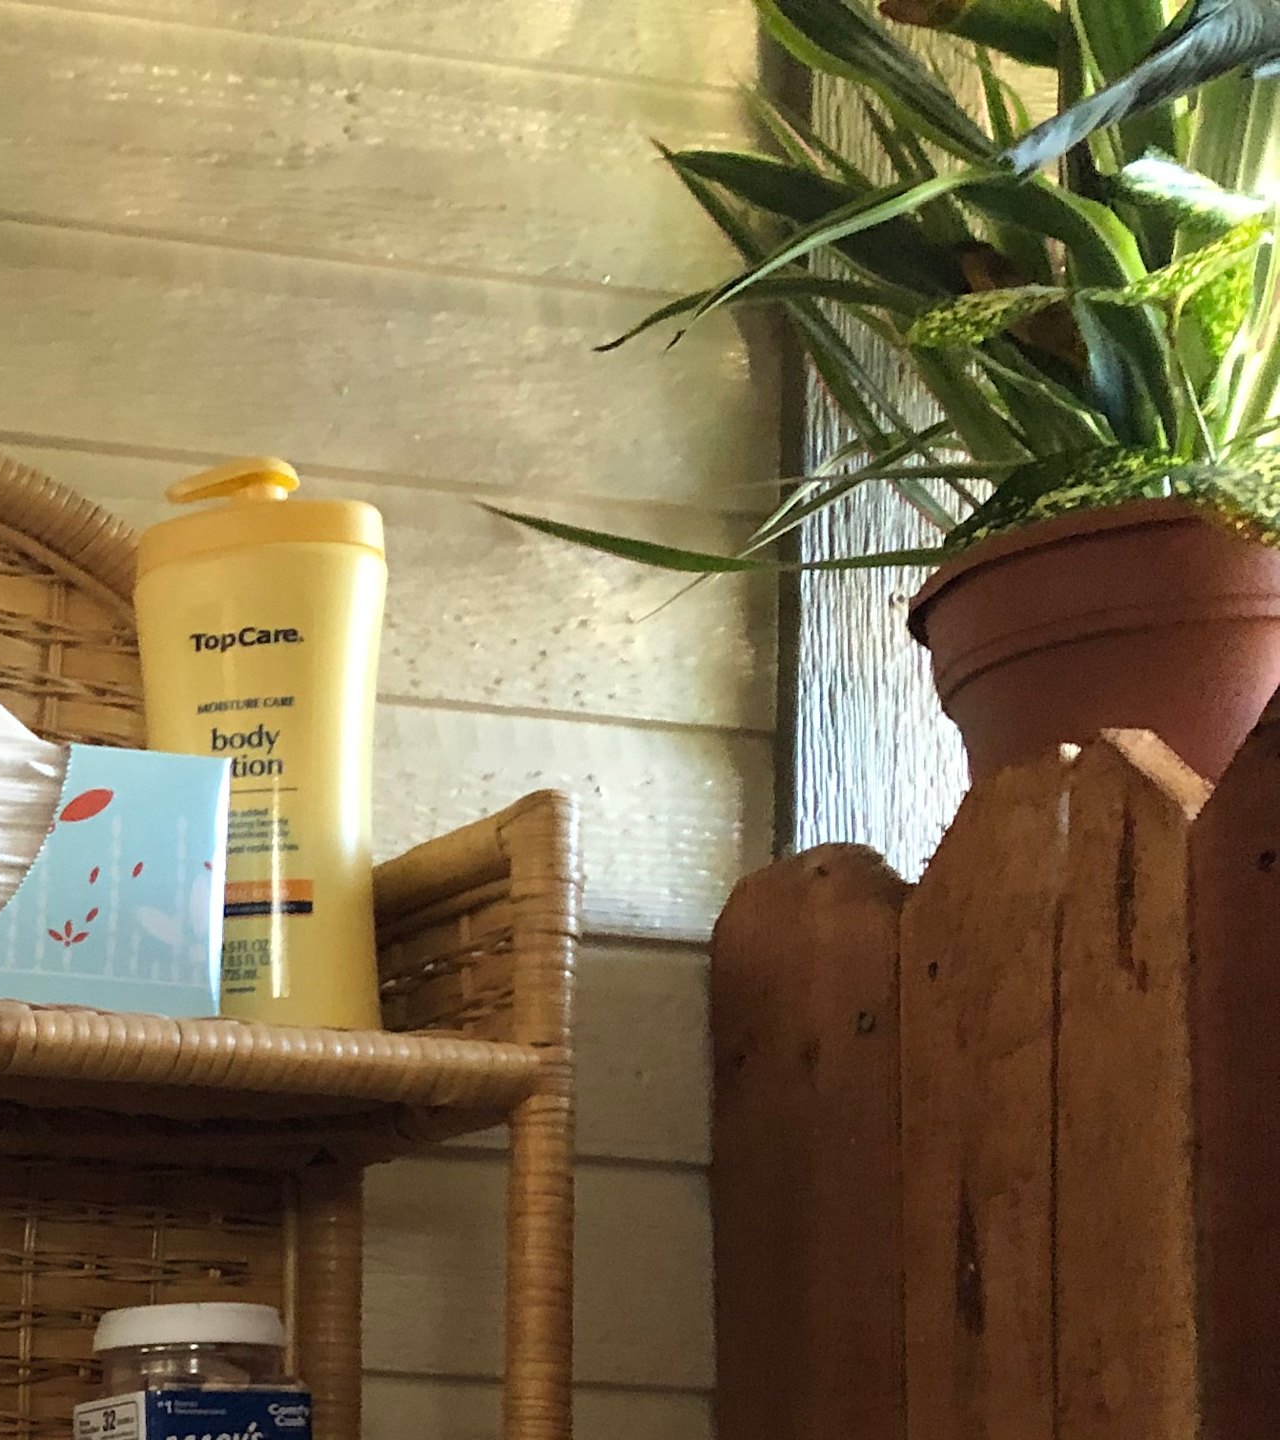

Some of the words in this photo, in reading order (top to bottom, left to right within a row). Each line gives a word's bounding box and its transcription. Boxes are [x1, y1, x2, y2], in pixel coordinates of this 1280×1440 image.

[190, 626, 299, 653] TopCare
[263, 696, 295, 708] CARE
[211, 723, 281, 755] body
[231, 753, 284, 778] tion
[102, 1409, 116, 1432] 32
